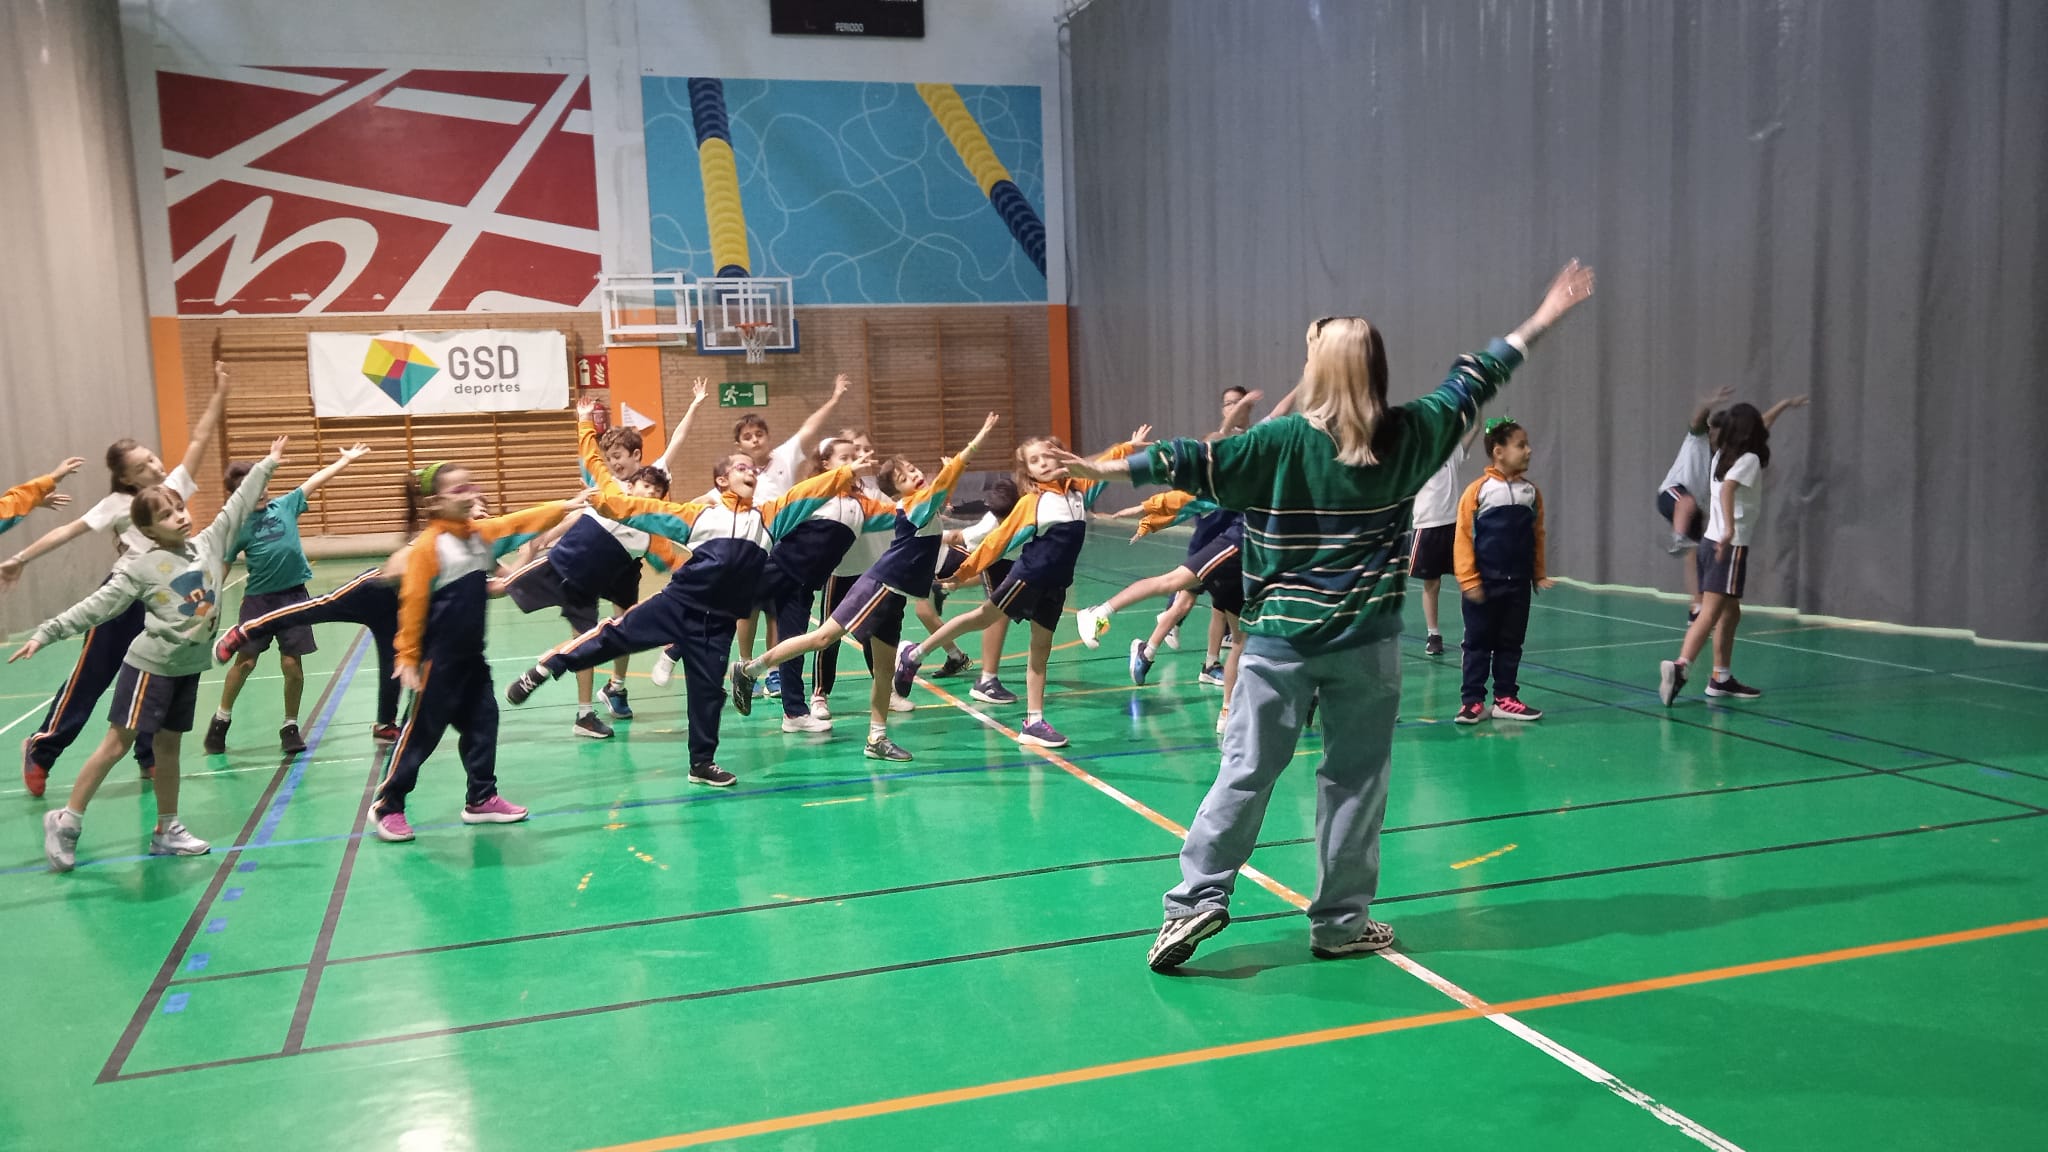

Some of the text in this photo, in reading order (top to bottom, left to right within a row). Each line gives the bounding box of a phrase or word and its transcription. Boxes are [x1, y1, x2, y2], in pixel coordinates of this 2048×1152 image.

[835, 22, 864, 32] PERIODO
[448, 345, 519, 380] GSD
[454, 382, 521, 396] deportes
